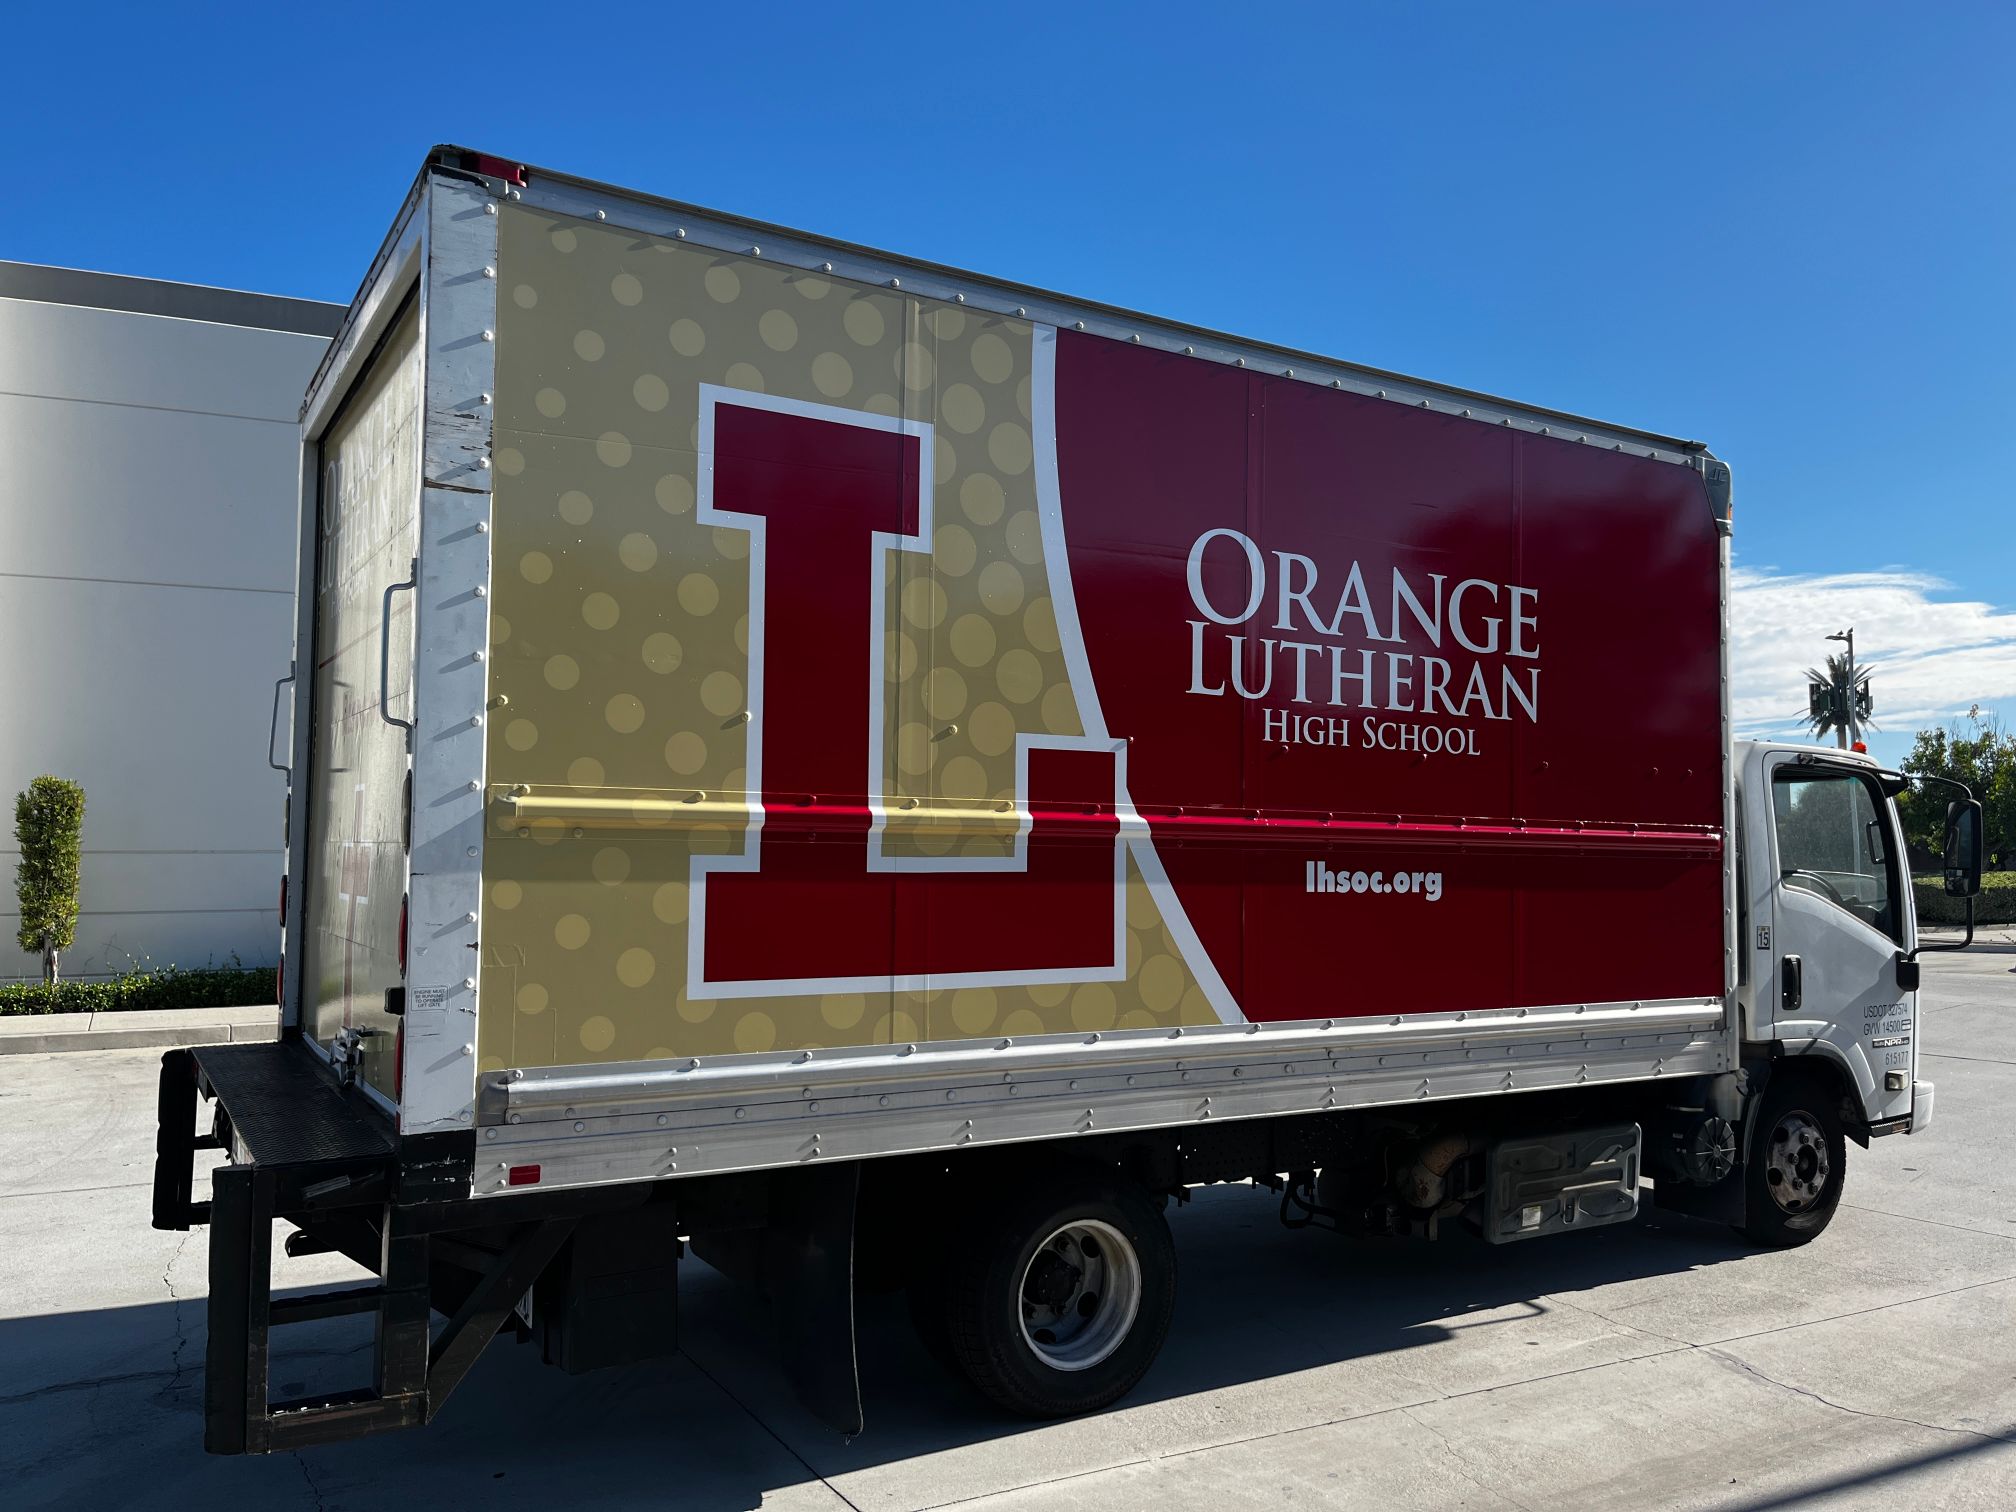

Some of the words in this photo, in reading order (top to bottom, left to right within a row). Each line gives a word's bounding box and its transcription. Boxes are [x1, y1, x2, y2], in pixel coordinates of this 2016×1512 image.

[1186, 528, 1541, 659] ORANGE
[1185, 619, 1542, 724] LUTHERAN
[687, 383, 1127, 1000] L
[1262, 708, 1351, 747] HIGH
[1361, 716, 1481, 756] SCHOOL
[1306, 860, 1443, 901] lhsoc.org
[1758, 931, 1769, 947] 15
[1863, 1004, 1887, 1018] USDOT
[1863, 1021, 1881, 1035] GVW
[1882, 1019, 1901, 1033] 14500
[1884, 1038, 1902, 1047] NPR
[1885, 1051, 1909, 1066] 615177
